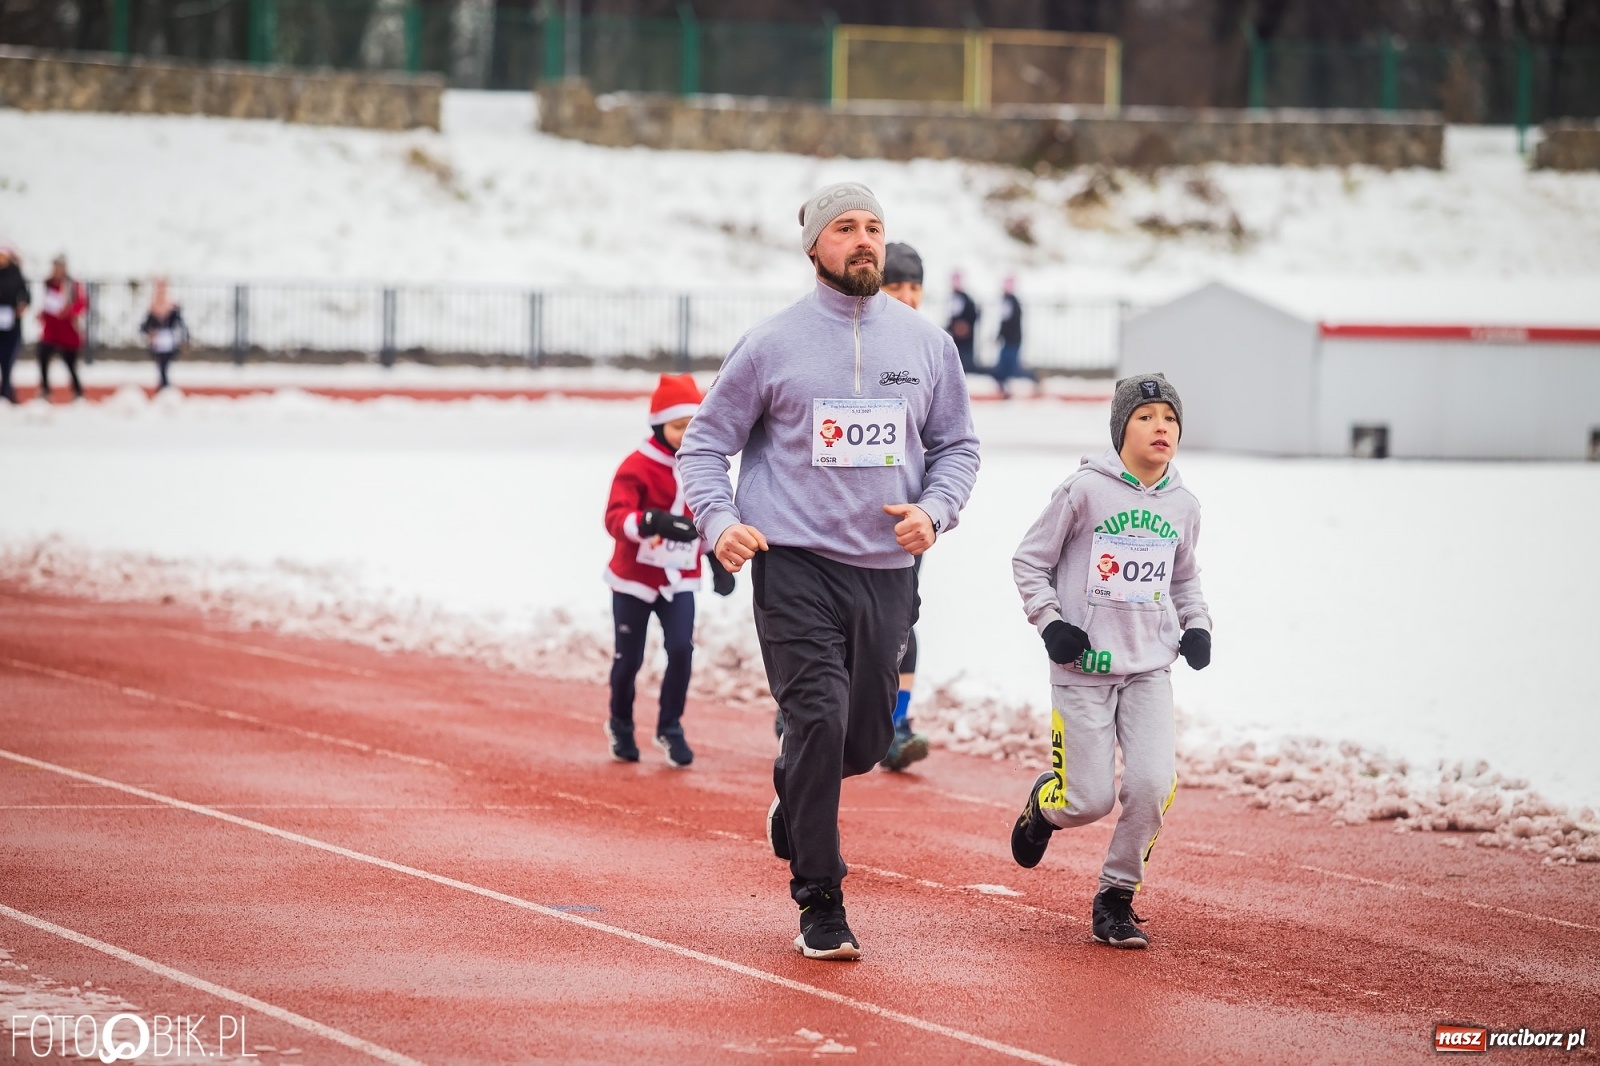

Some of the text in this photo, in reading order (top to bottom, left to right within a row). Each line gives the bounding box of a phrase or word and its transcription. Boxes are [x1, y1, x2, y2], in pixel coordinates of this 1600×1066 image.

[846, 423, 897, 446] 023
[1122, 561, 1166, 582] 024
[1082, 649, 1112, 674] 08
